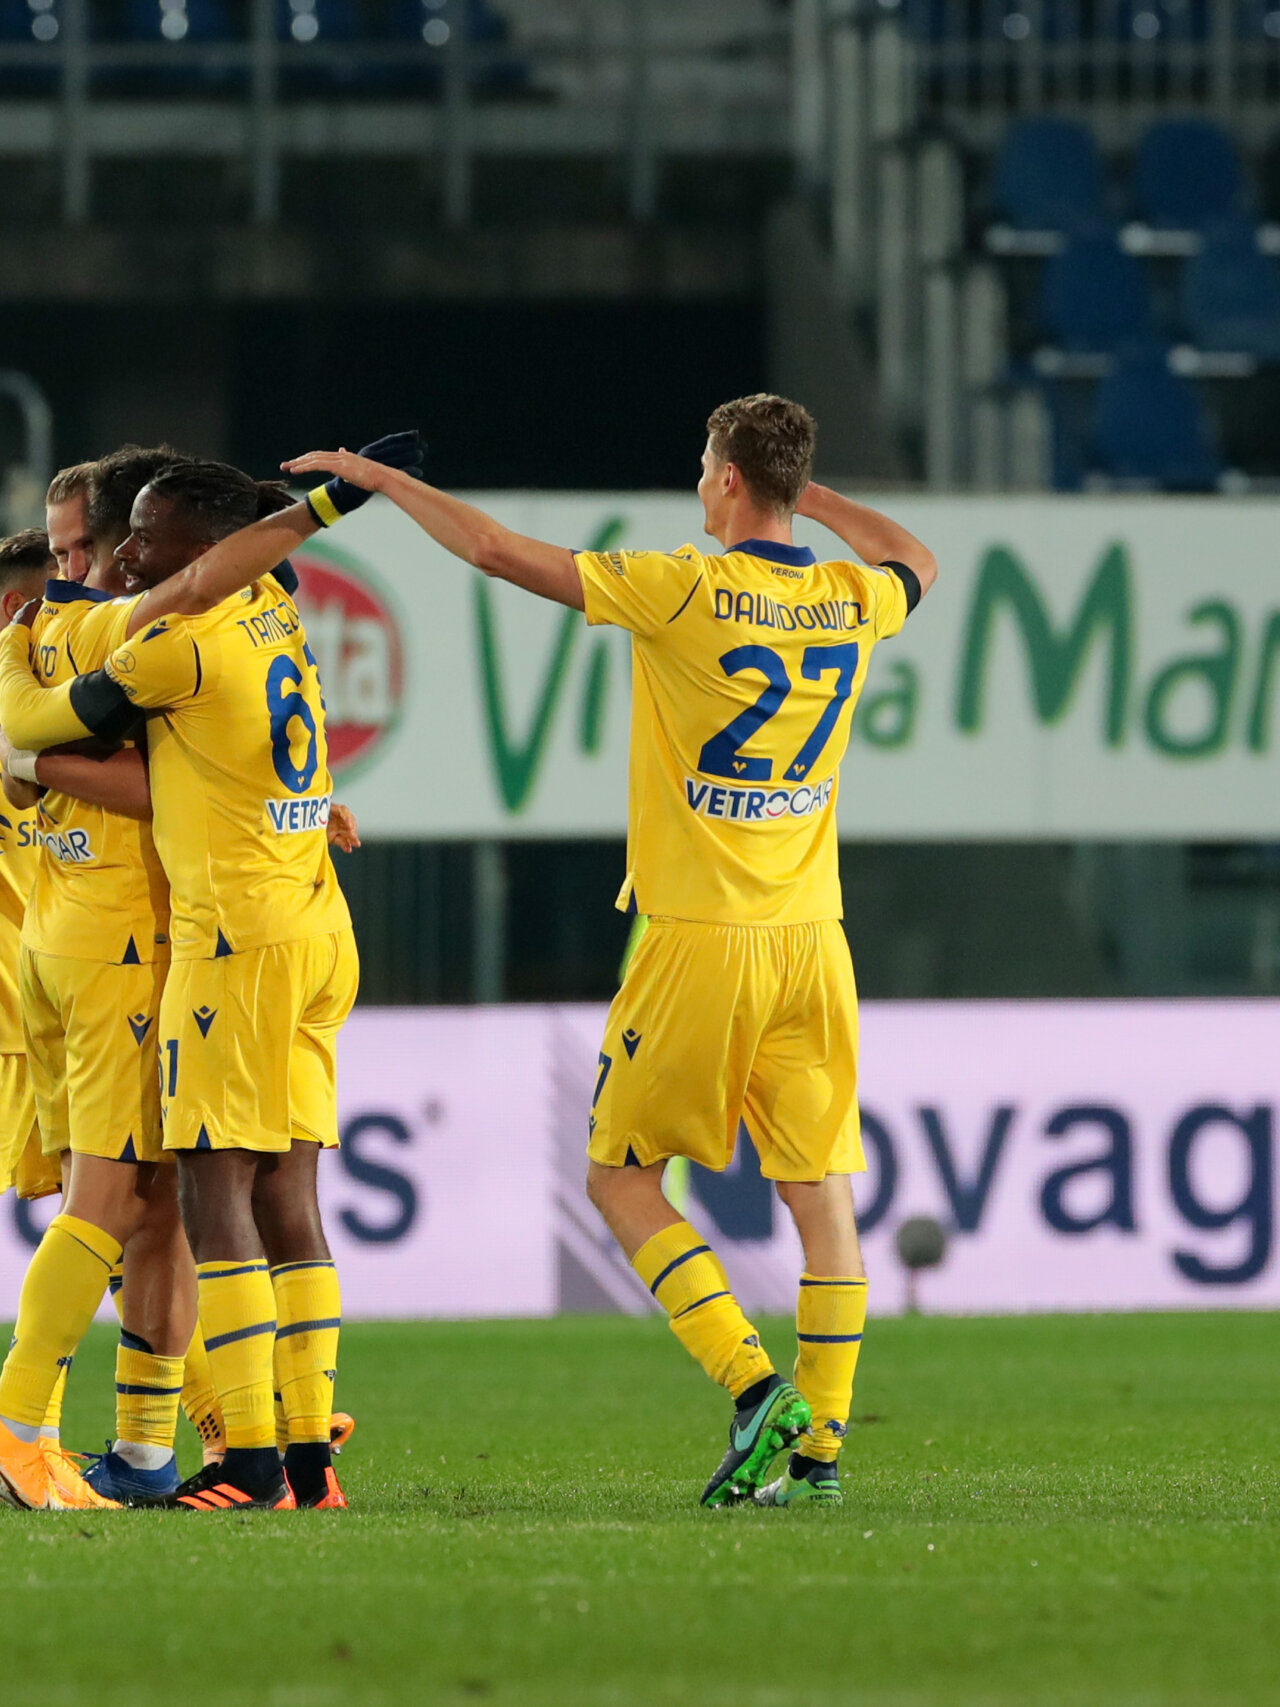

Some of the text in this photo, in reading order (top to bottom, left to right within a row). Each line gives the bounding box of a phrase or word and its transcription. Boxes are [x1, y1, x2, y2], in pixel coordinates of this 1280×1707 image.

[770, 566, 805, 580] VERONA
[714, 588, 870, 631] DAWIDOWICZ
[696, 642, 859, 782] 27
[269, 796, 332, 832] VETRO
[686, 778, 833, 818] VETROCAR
[591, 1051, 612, 1109] 7
